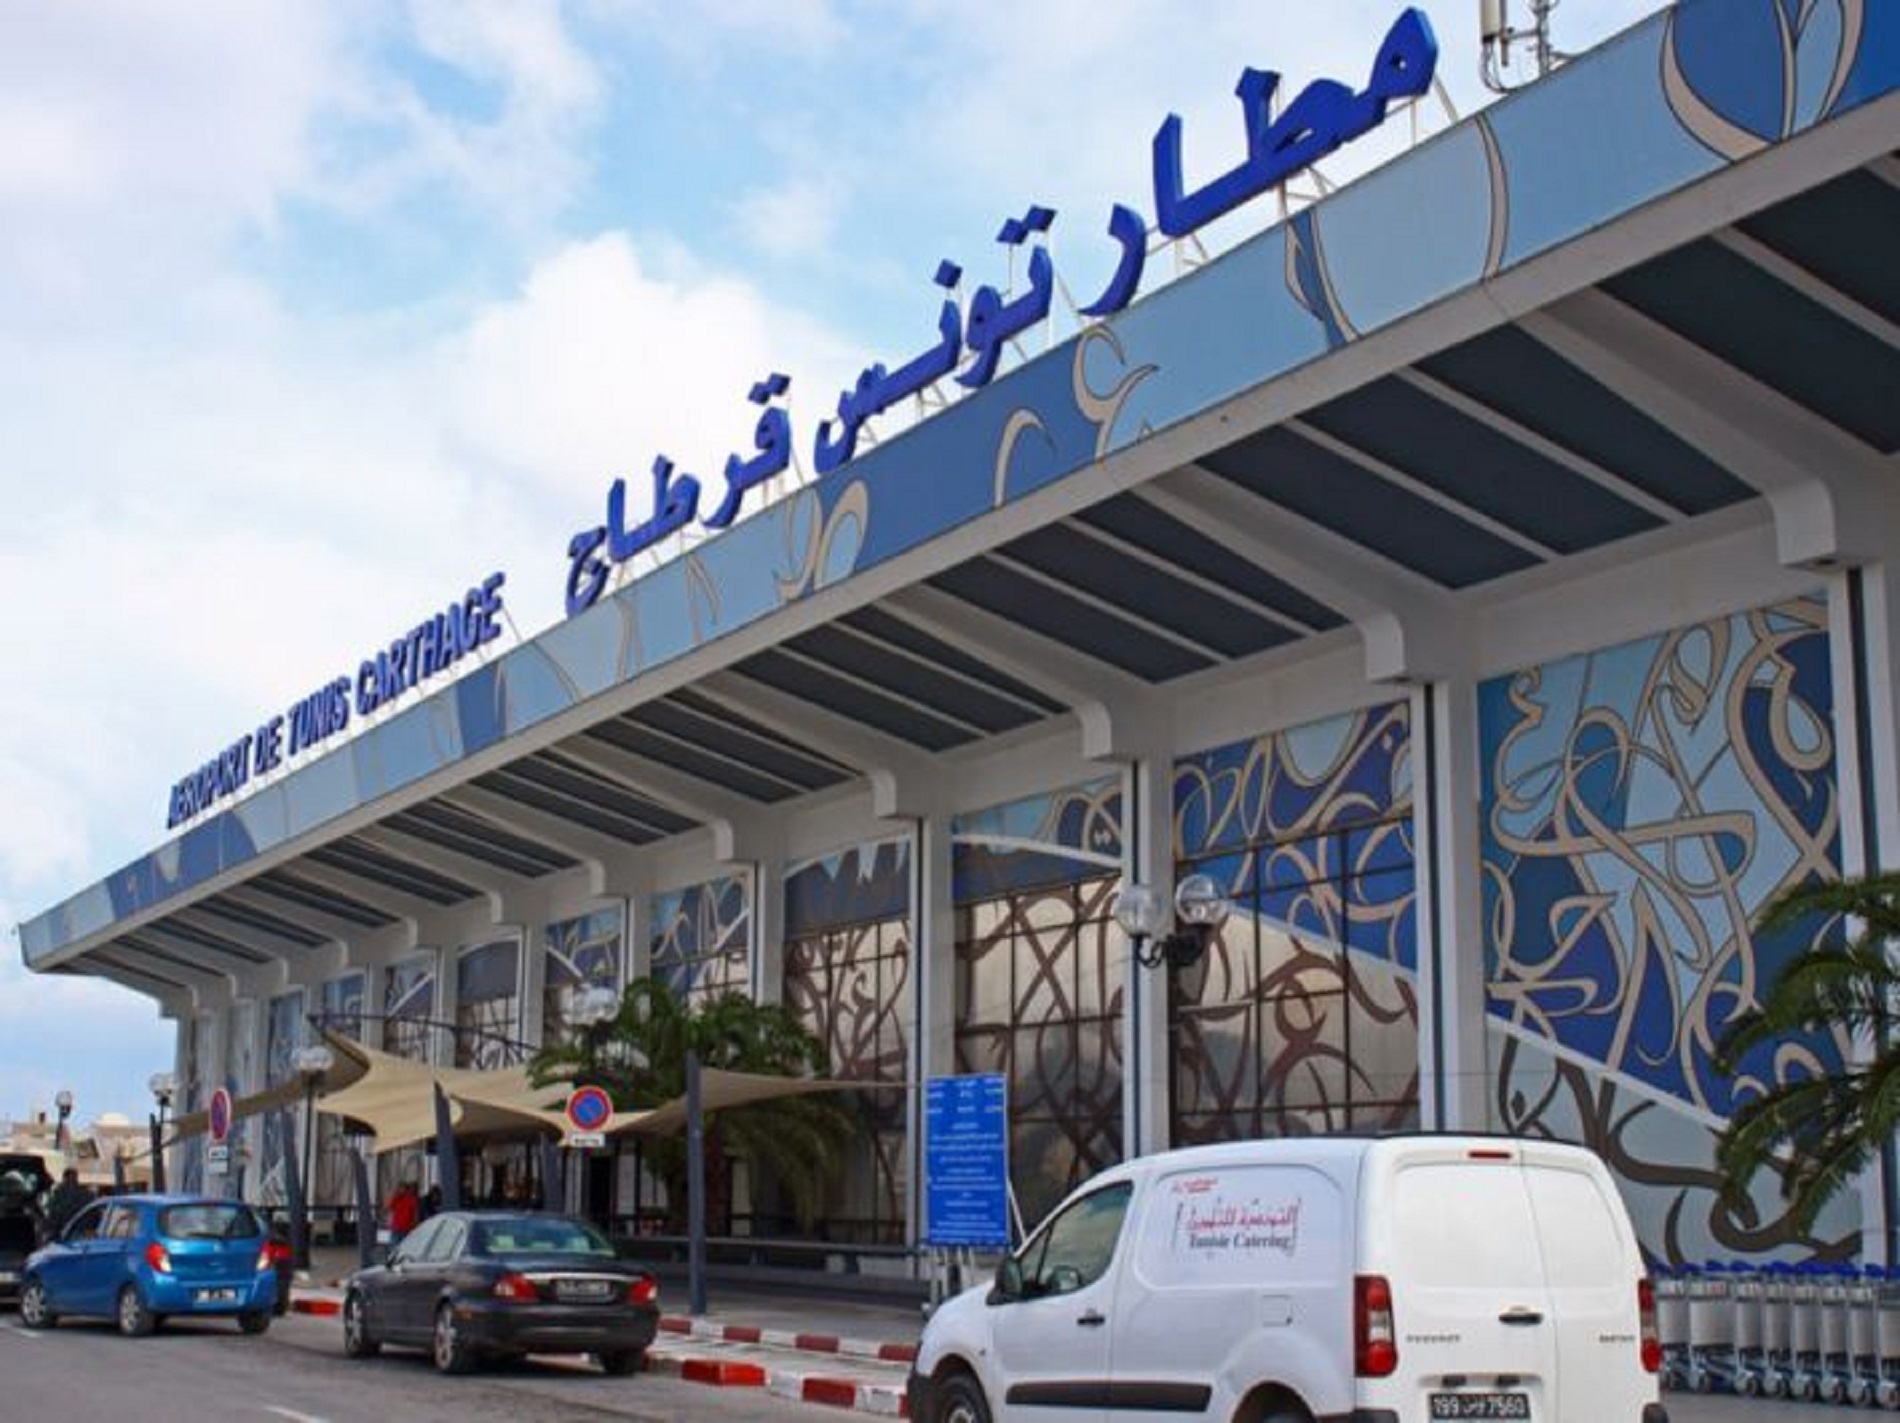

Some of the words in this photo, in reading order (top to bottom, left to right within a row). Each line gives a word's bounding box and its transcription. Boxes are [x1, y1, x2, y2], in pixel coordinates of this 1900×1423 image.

[1080, 7, 1439, 317] مطار
[814, 205, 1056, 475] تونس
[566, 372, 793, 618] قرطاج
[254, 715, 285, 776] DE
[287, 676, 352, 756] TUNIS
[355, 571, 506, 716] CARTHAGE
[1232, 1232, 1291, 1251] Catering
